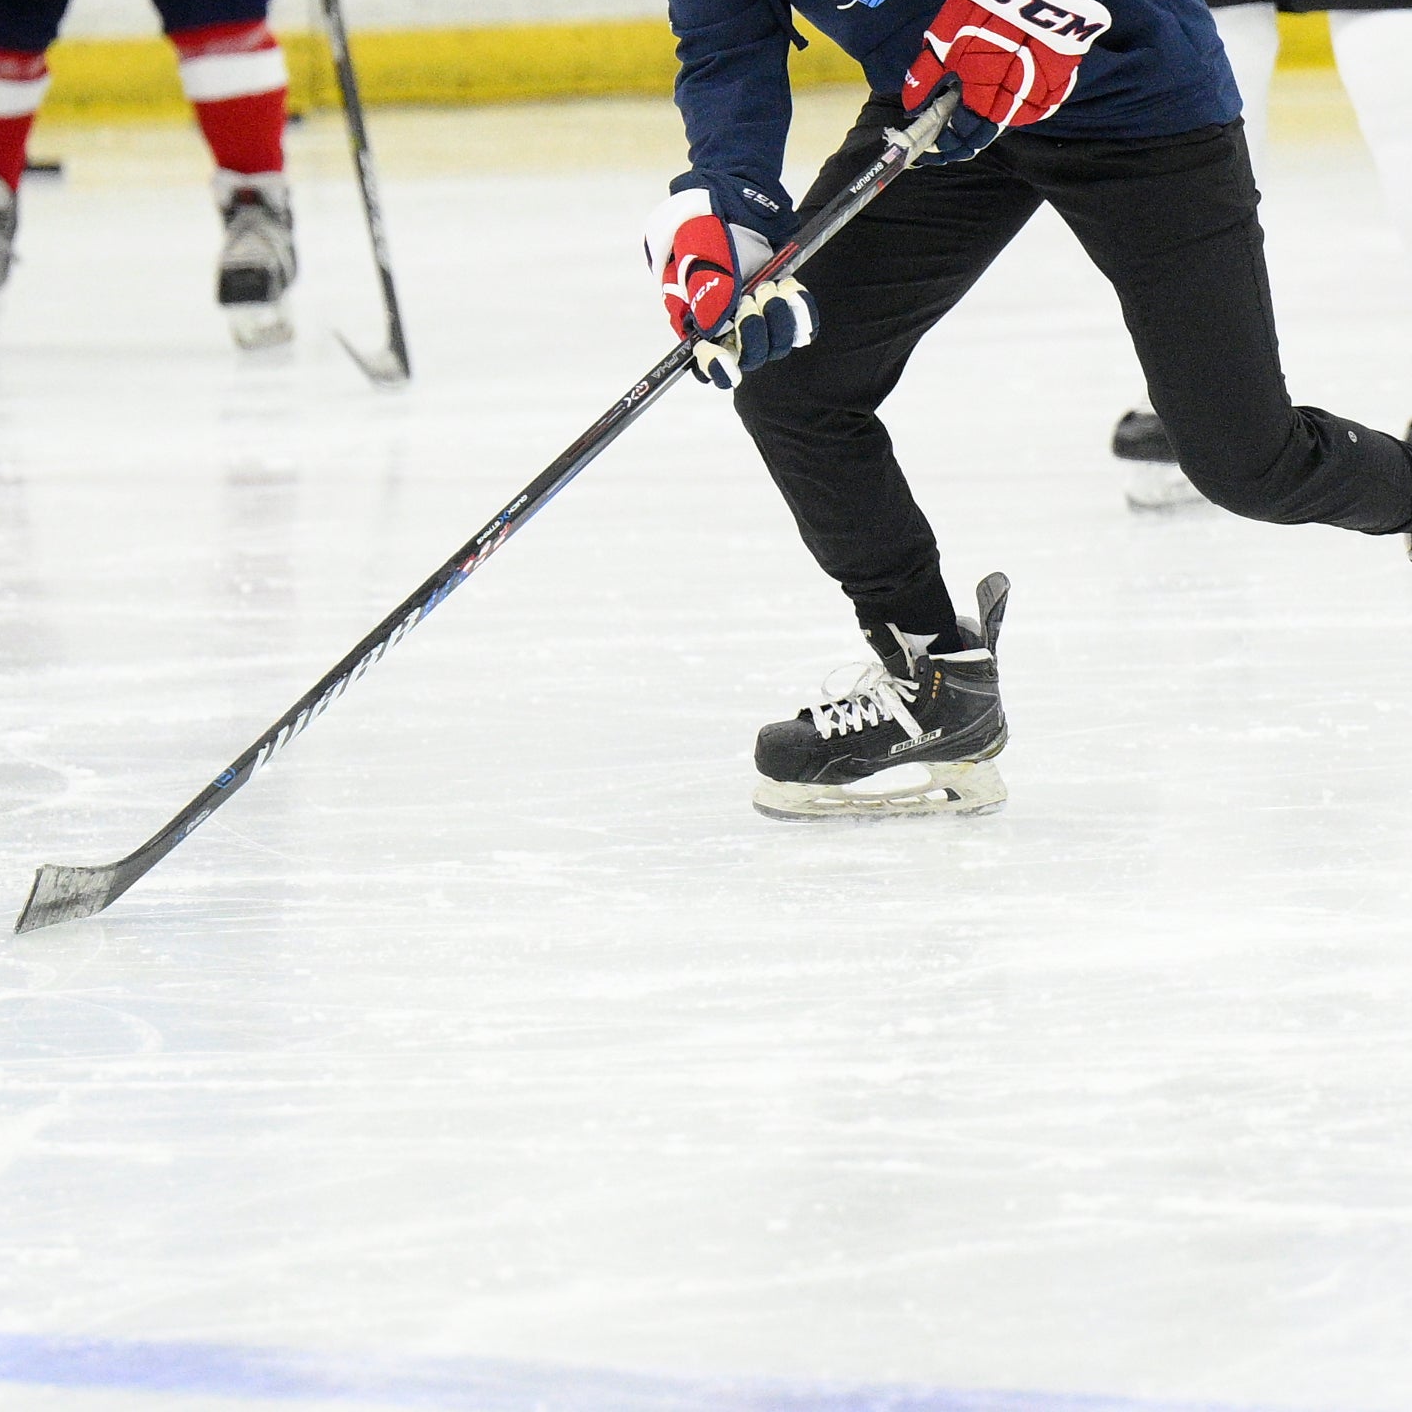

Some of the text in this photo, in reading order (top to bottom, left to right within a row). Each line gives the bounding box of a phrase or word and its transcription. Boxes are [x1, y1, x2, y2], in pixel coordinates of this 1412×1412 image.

[849, 161, 885, 194] SKARUPA
[690, 277, 720, 314] CCM
[650, 339, 692, 379] ALPHA
